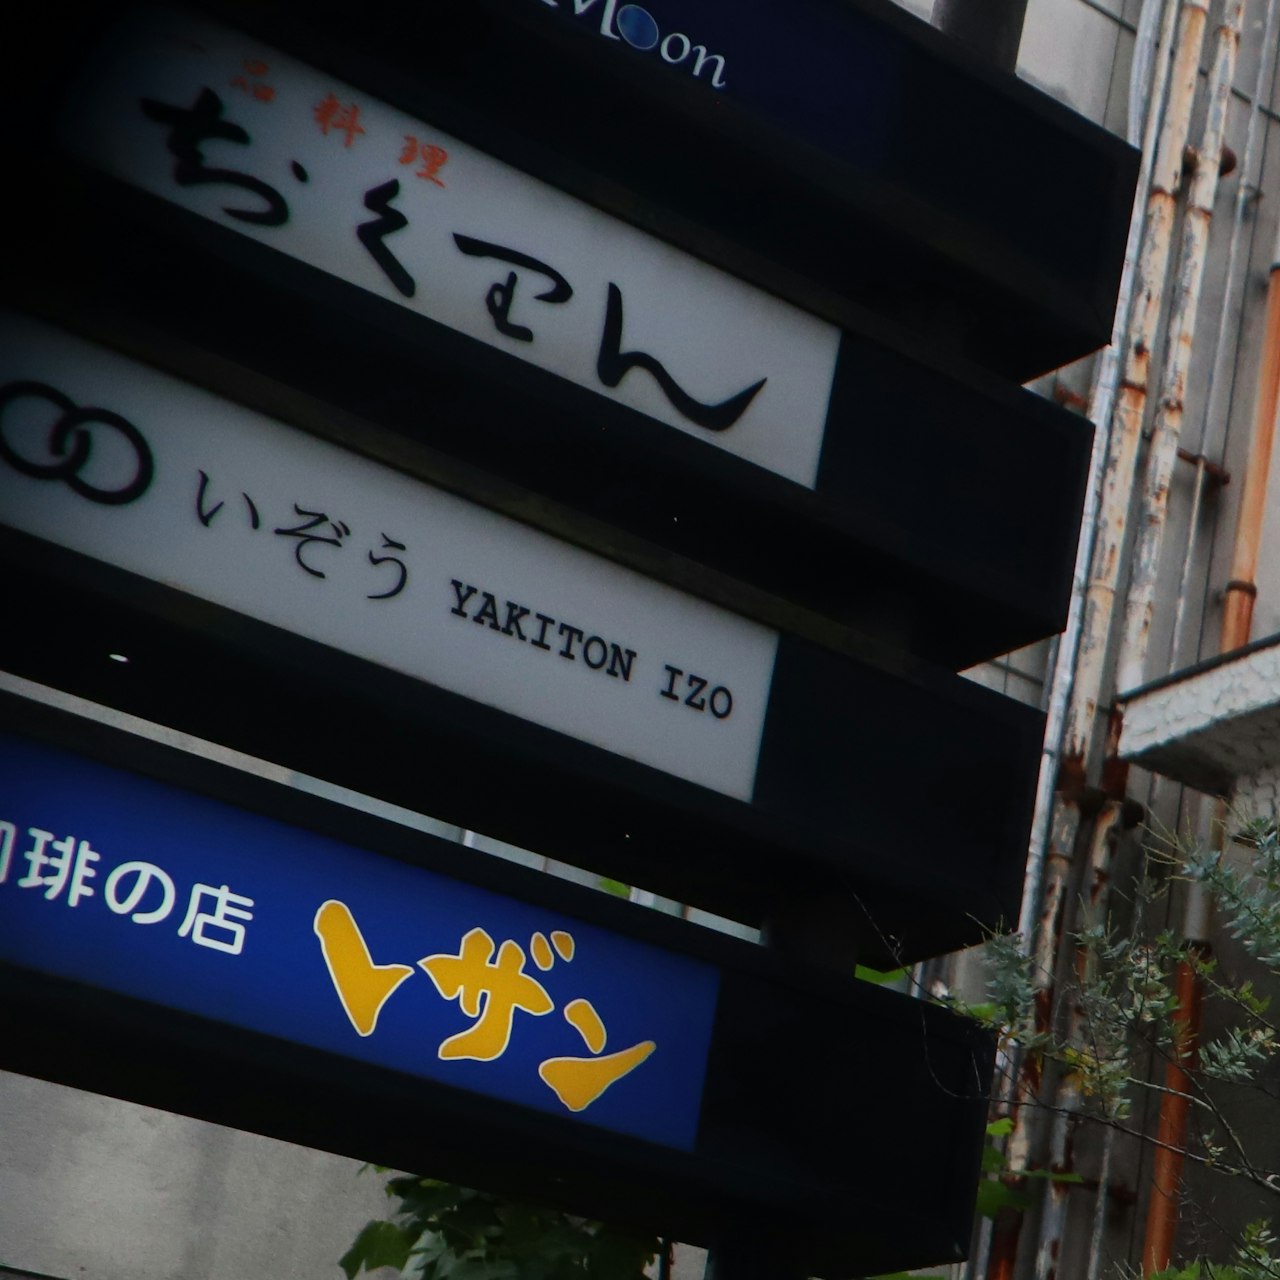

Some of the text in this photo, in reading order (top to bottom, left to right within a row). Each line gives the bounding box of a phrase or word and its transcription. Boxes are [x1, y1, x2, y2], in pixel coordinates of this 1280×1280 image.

[193, 467, 735, 720] いぞう YAKITON IZO
[312, 897, 659, 1113] レザン
